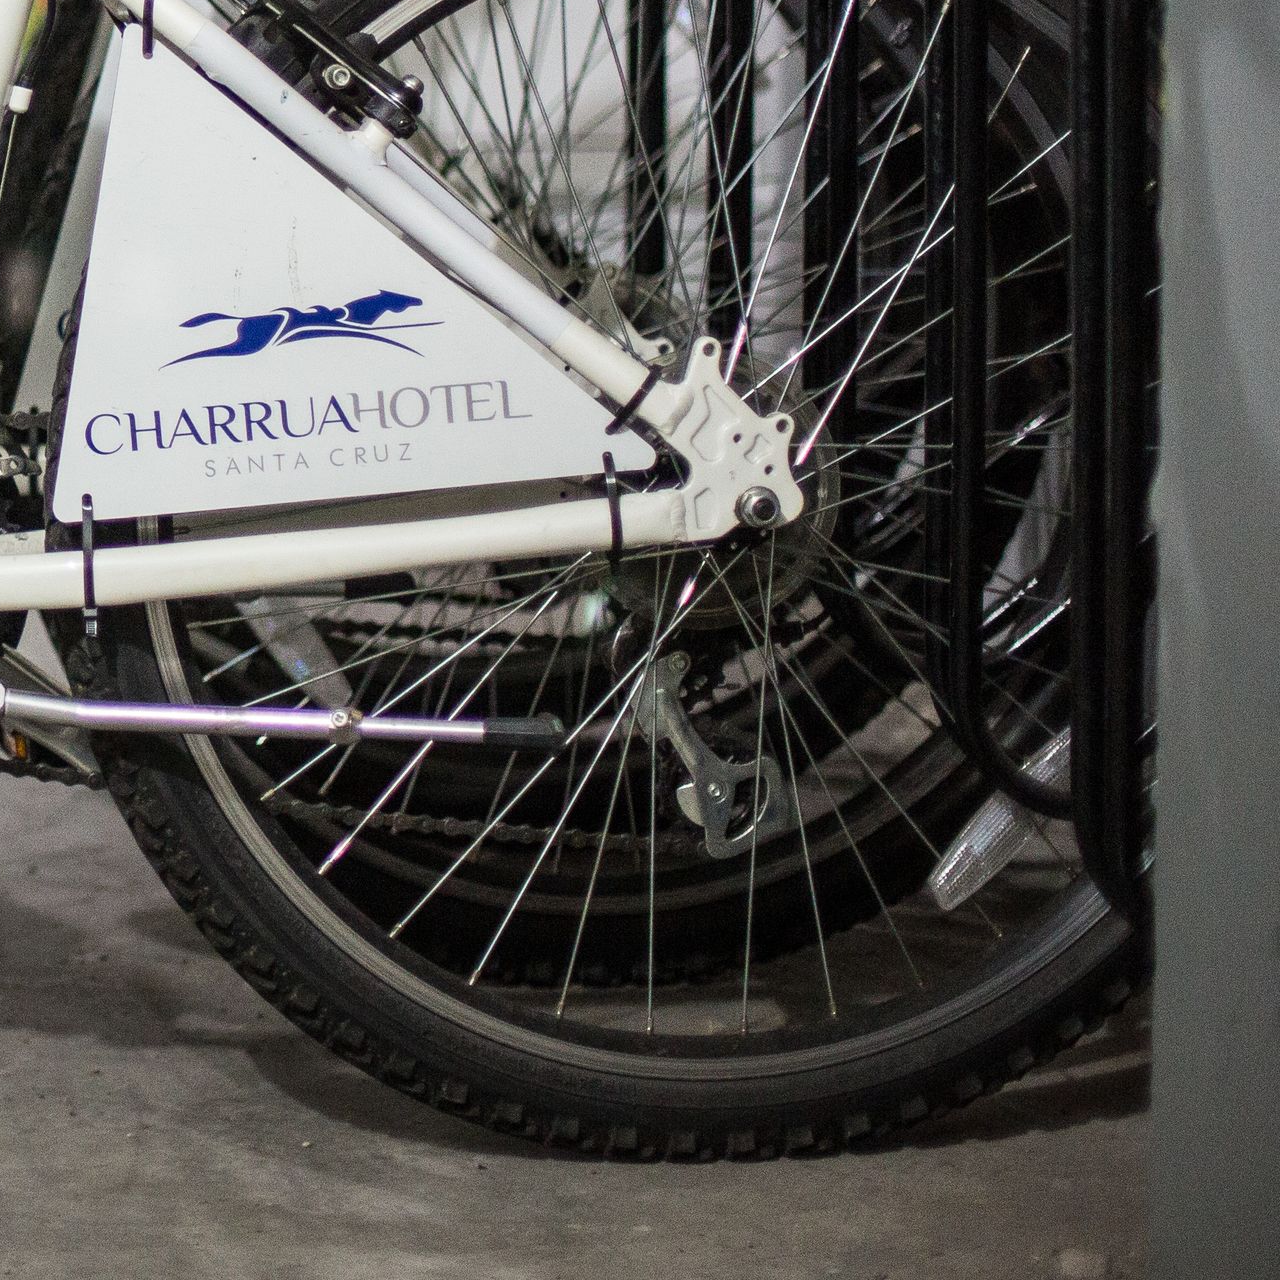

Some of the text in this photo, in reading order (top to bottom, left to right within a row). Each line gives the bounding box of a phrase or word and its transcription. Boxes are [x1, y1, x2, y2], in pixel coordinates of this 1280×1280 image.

[85, 380, 532, 456] CHARRUAHOTEL
[204, 442, 413, 478] SANTA CRUZ
